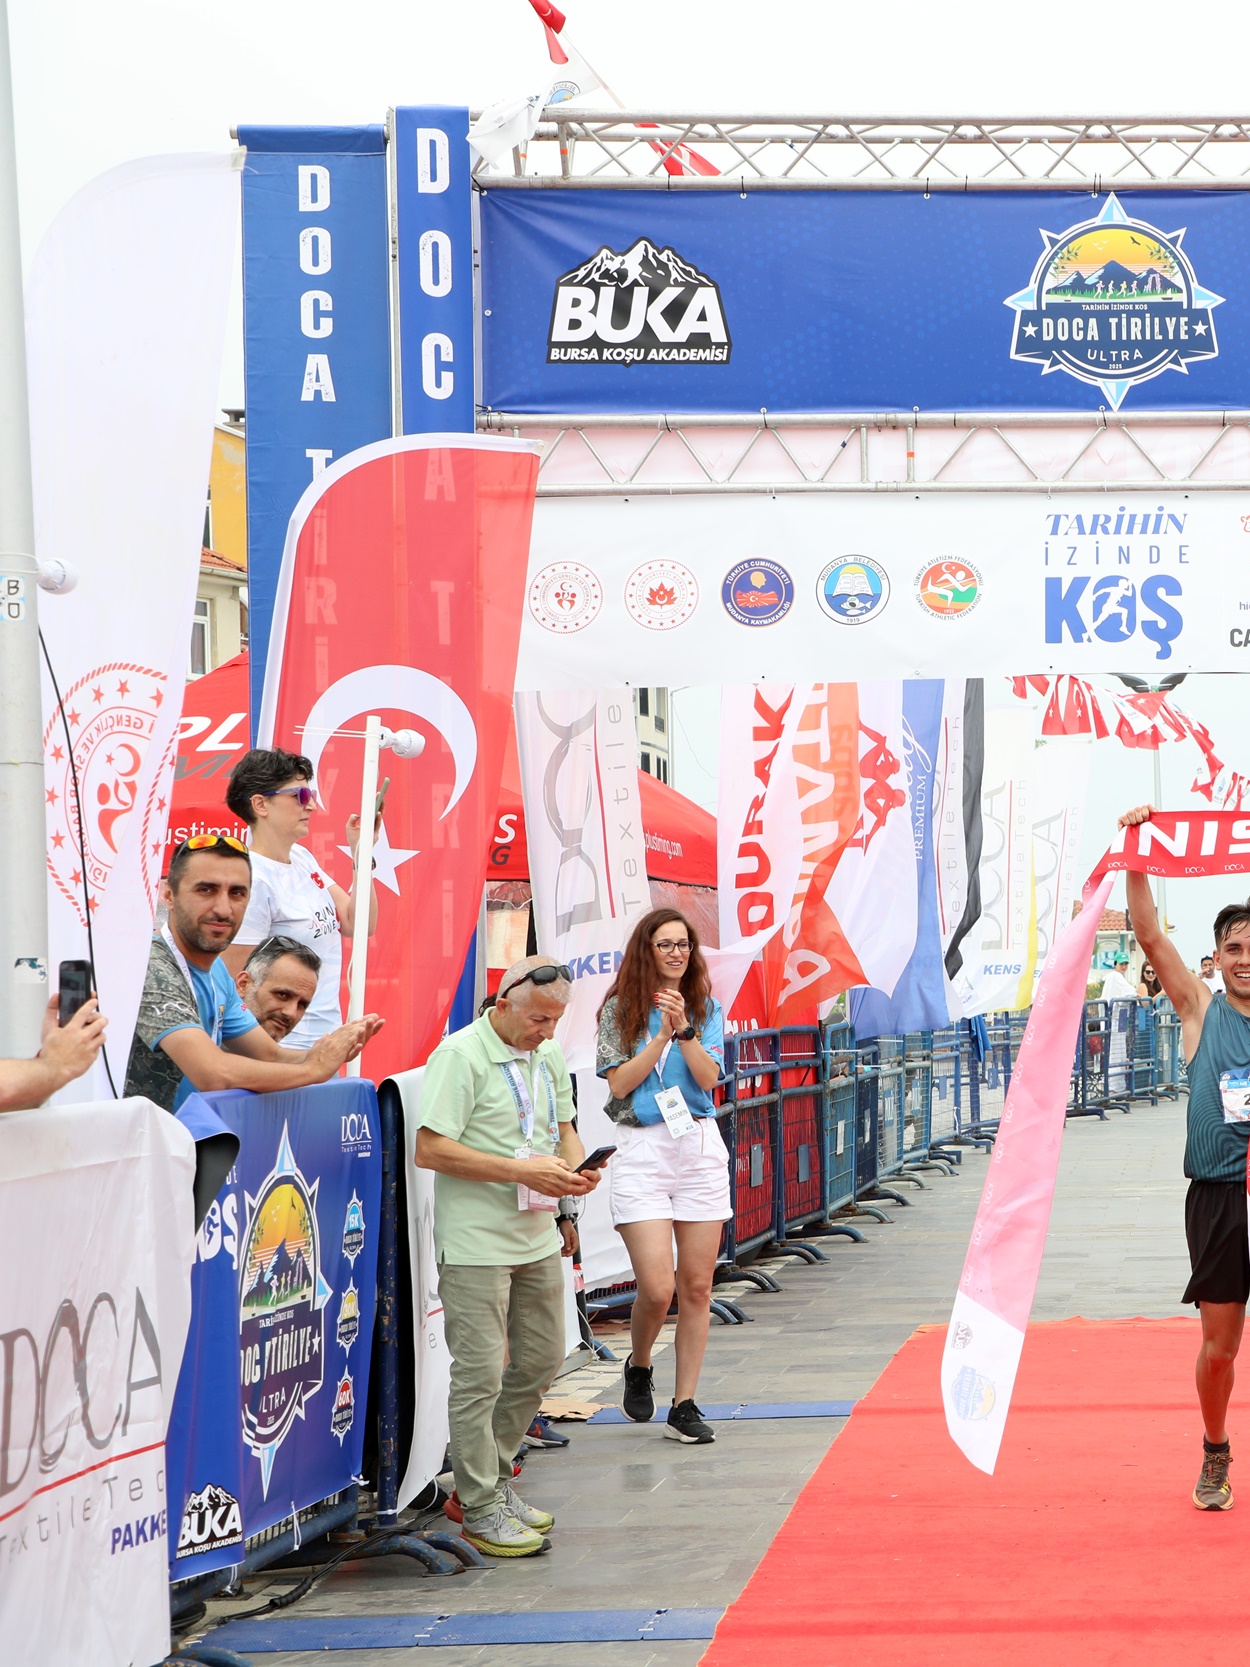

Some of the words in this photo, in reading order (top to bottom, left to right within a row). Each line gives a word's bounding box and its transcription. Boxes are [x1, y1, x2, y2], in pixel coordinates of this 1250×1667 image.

[298, 165, 337, 402] DOCA
[550, 286, 730, 343] BUKA
[1081, 303, 1110, 311] TARİHİN
[1110, 303, 1134, 311] İZİNDE
[1042, 317, 1099, 341] DOCA
[1109, 313, 1189, 341] TİRİLYE
[550, 347, 599, 362] BURSA
[602, 346, 645, 366] KOŞU
[646, 343, 729, 362] AKADEMİSİ
[1087, 349, 1143, 362] ULTRA
[1045, 505, 1188, 536] TARİHİN
[1045, 540, 1190, 566] İZİNDE
[726, 562, 750, 585] TÜRKİYE
[749, 560, 792, 585] CUMHURİYETİ
[820, 557, 849, 582] MUDANYA
[852, 556, 887, 582] BELEDİYESİ
[725, 601, 750, 625] MUDANYA
[1044, 574, 1184, 660] KOŞ
[913, 774, 928, 860] PREMIUM
[341, 1113, 372, 1142] DOCA
